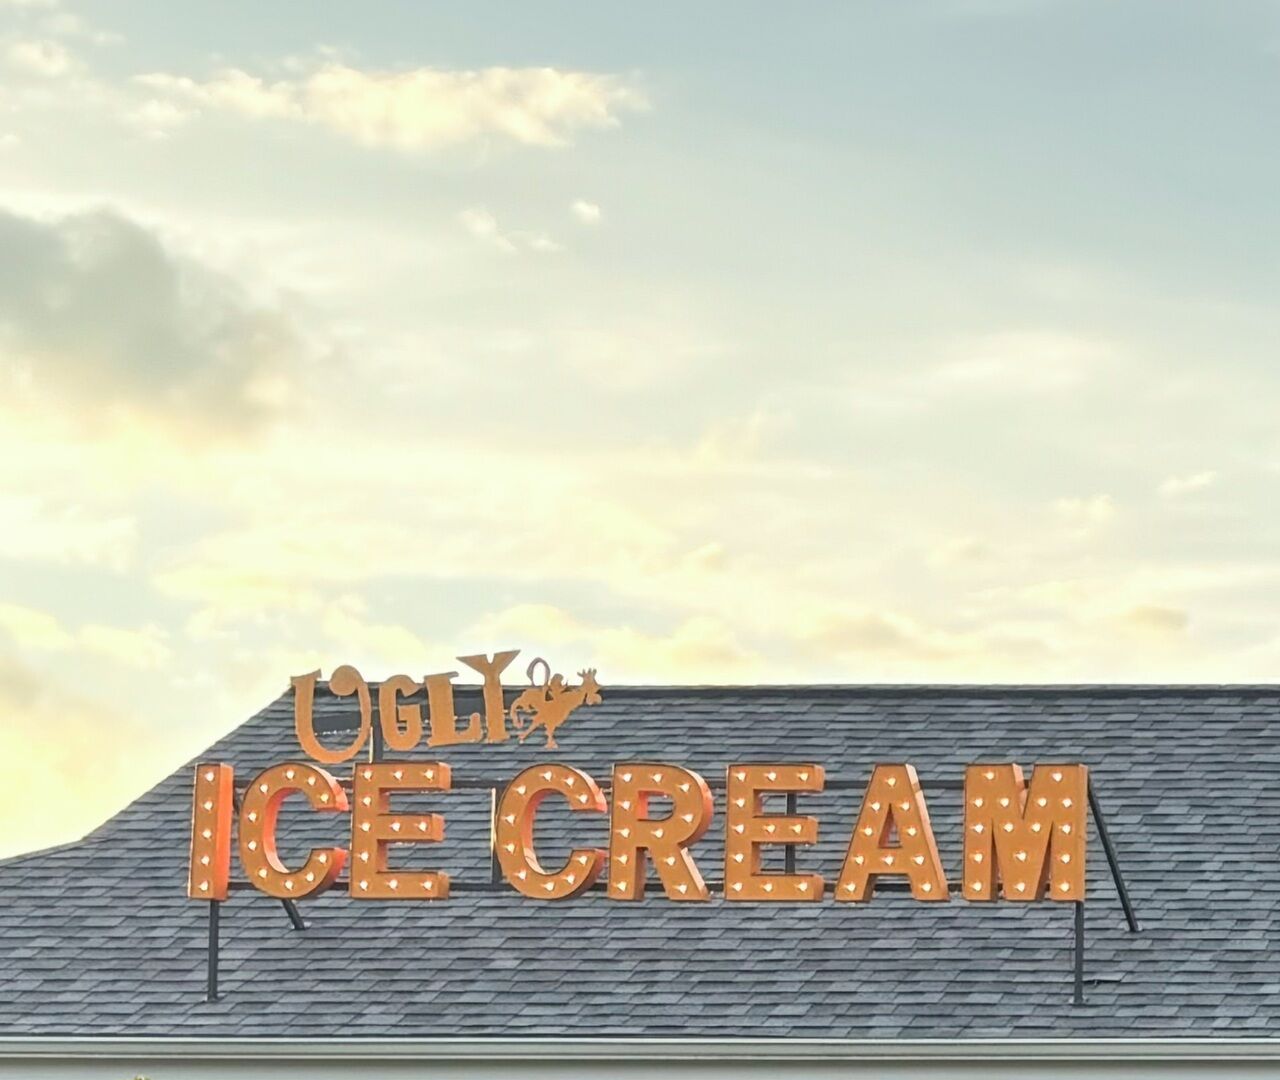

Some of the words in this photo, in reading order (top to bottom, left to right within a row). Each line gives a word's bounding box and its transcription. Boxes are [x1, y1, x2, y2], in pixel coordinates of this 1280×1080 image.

[291, 649, 521, 763] UGLY
[187, 762, 451, 901] ICE
[494, 763, 1089, 903] CREAM
